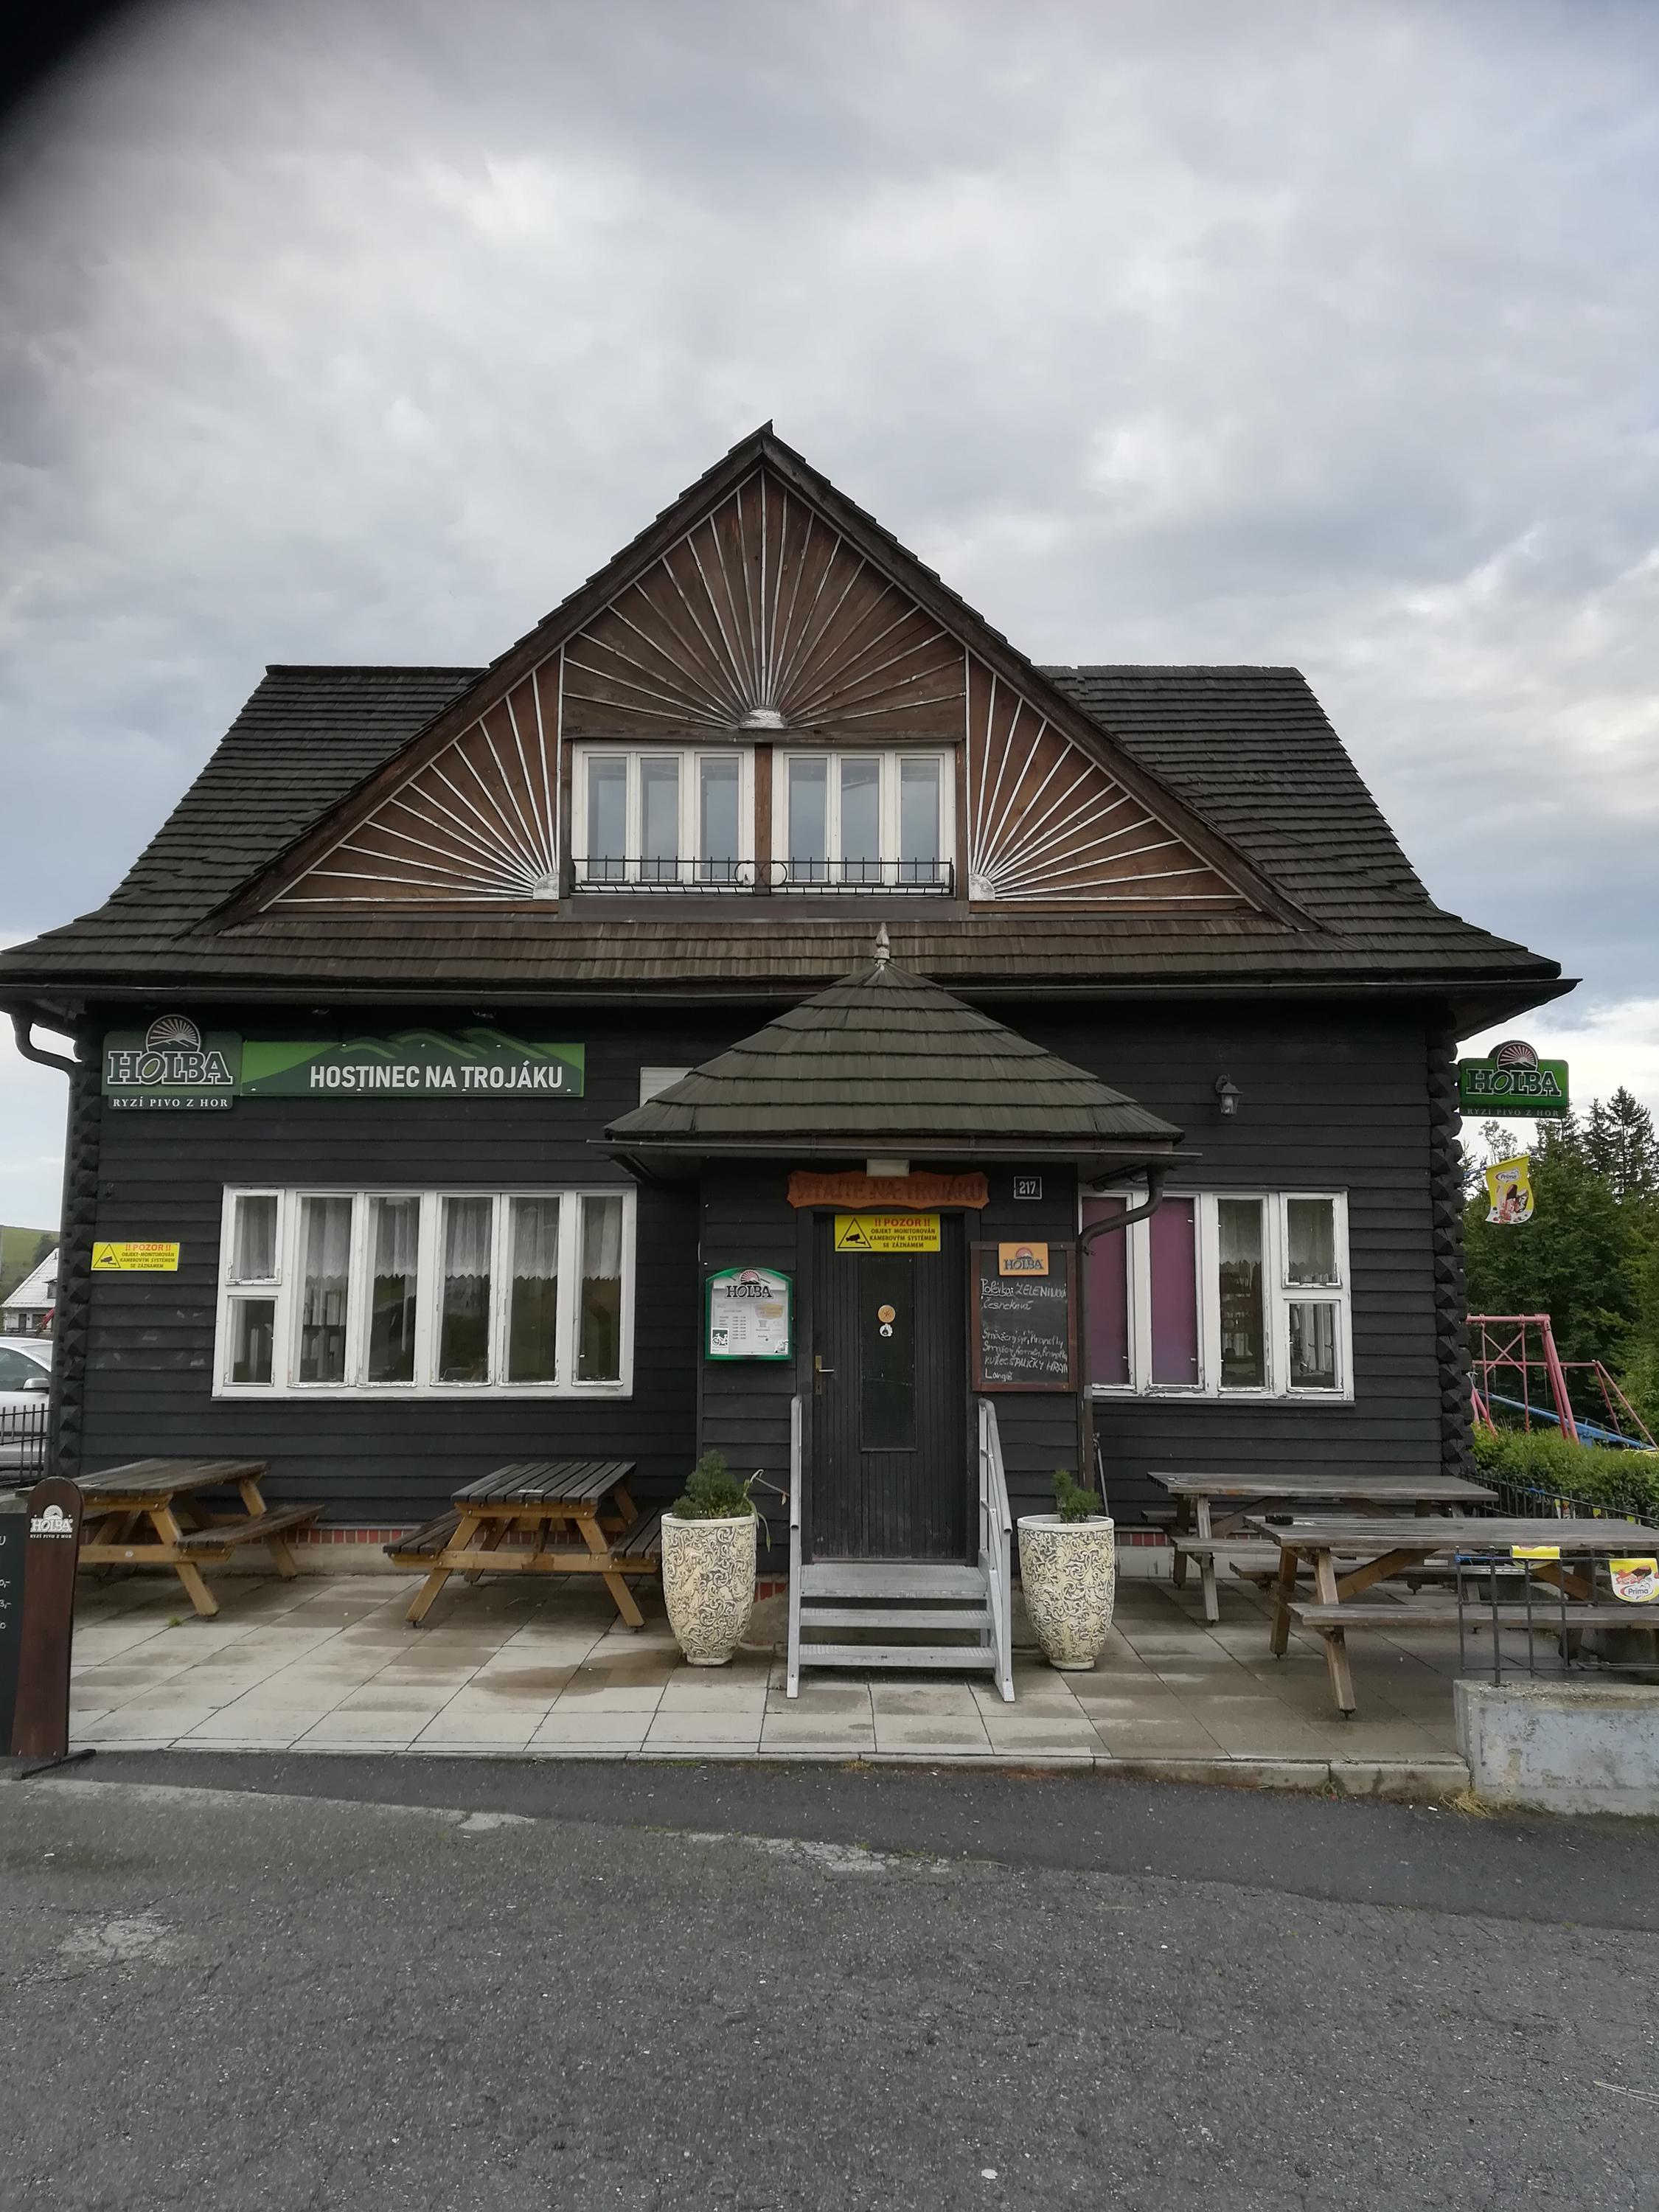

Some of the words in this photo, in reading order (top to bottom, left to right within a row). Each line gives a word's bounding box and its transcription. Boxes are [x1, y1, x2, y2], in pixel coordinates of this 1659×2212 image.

[107, 1051, 233, 1085] HOLBA
[310, 1065, 420, 1088] HOSTINEC
[425, 1065, 456, 1088] NA
[461, 1060, 563, 1088] TROJÁKU
[1466, 1069, 1562, 1096] HOLBA
[113, 1096, 144, 1107] RYZÍ
[150, 1099, 180, 1107] PIVO
[186, 1099, 194, 1107] Z
[200, 1099, 228, 1107] HOR
[1537, 1109, 1559, 1117] HOR
[1019, 1180, 1036, 1194] 217
[884, 1219, 921, 1227] POZOR
[1004, 1259, 1044, 1270] HOLBA
[726, 1285, 773, 1298] HOLBA
[30, 1518, 72, 1533] HOLBA
